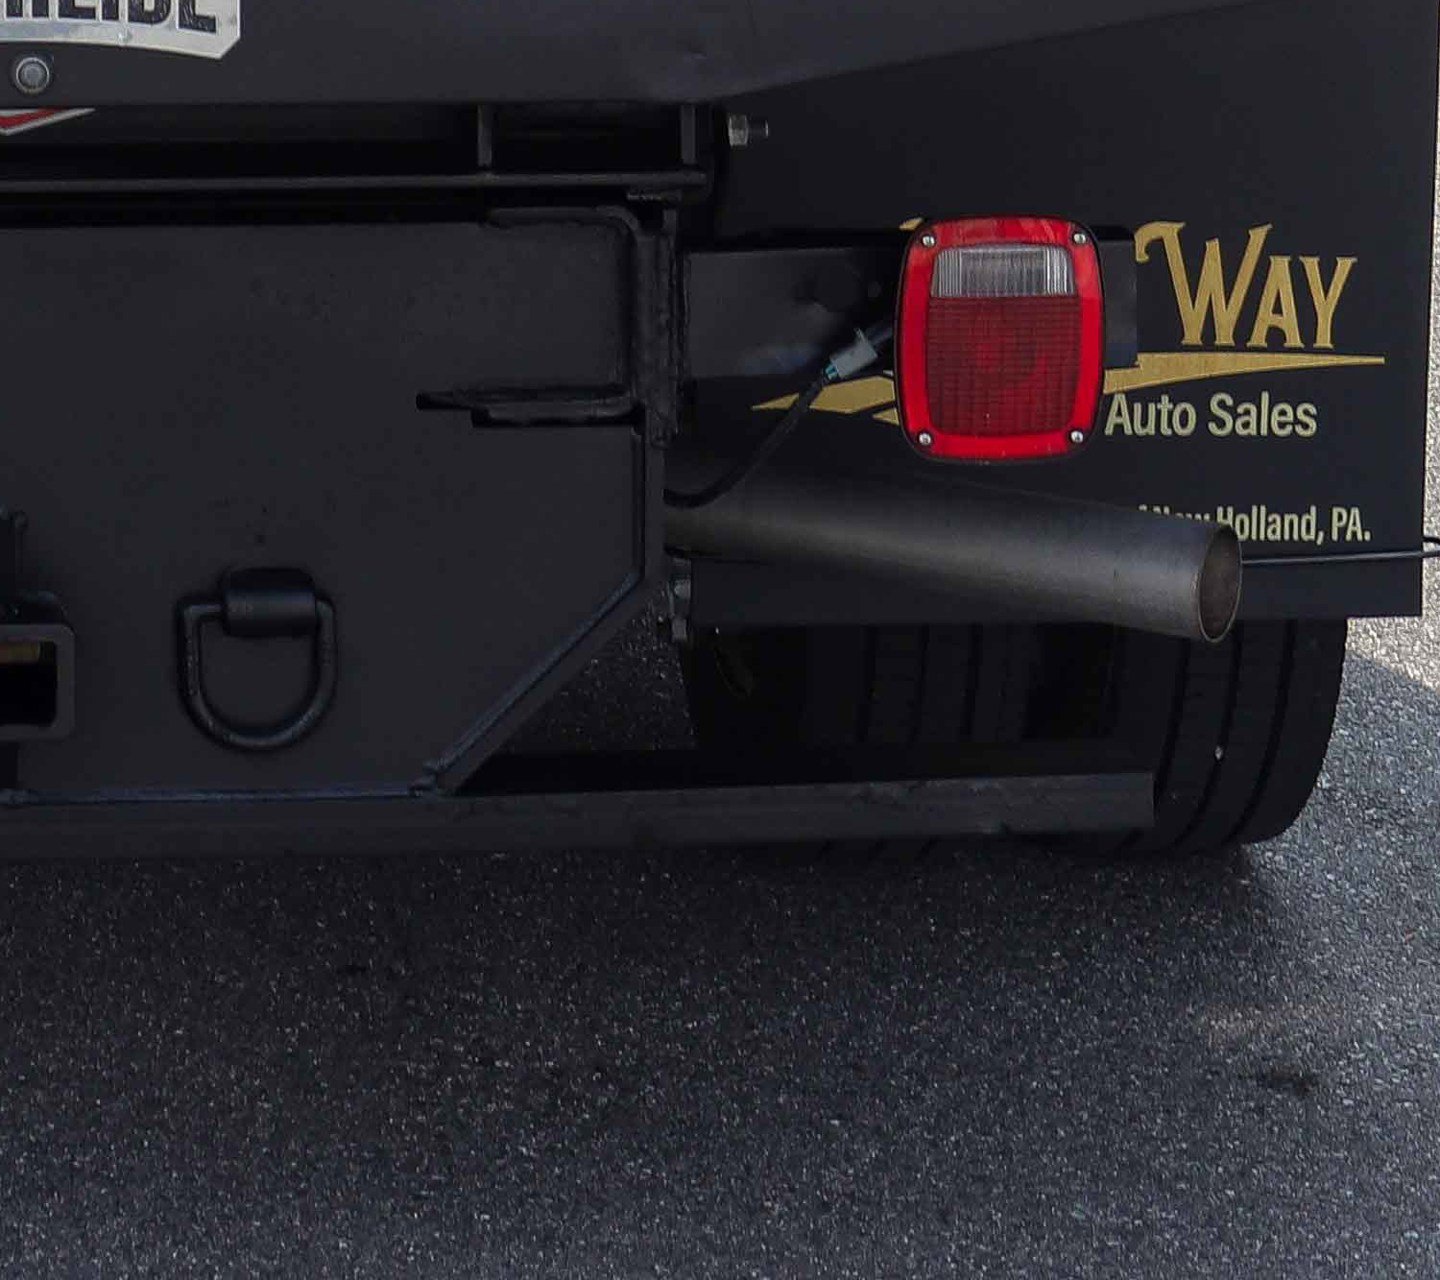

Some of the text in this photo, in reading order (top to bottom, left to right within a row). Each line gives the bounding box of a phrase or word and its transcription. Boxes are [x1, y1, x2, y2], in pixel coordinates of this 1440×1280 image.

[1104, 391, 1318, 437] Auto Sales
[1331, 506, 1372, 542] PA.
